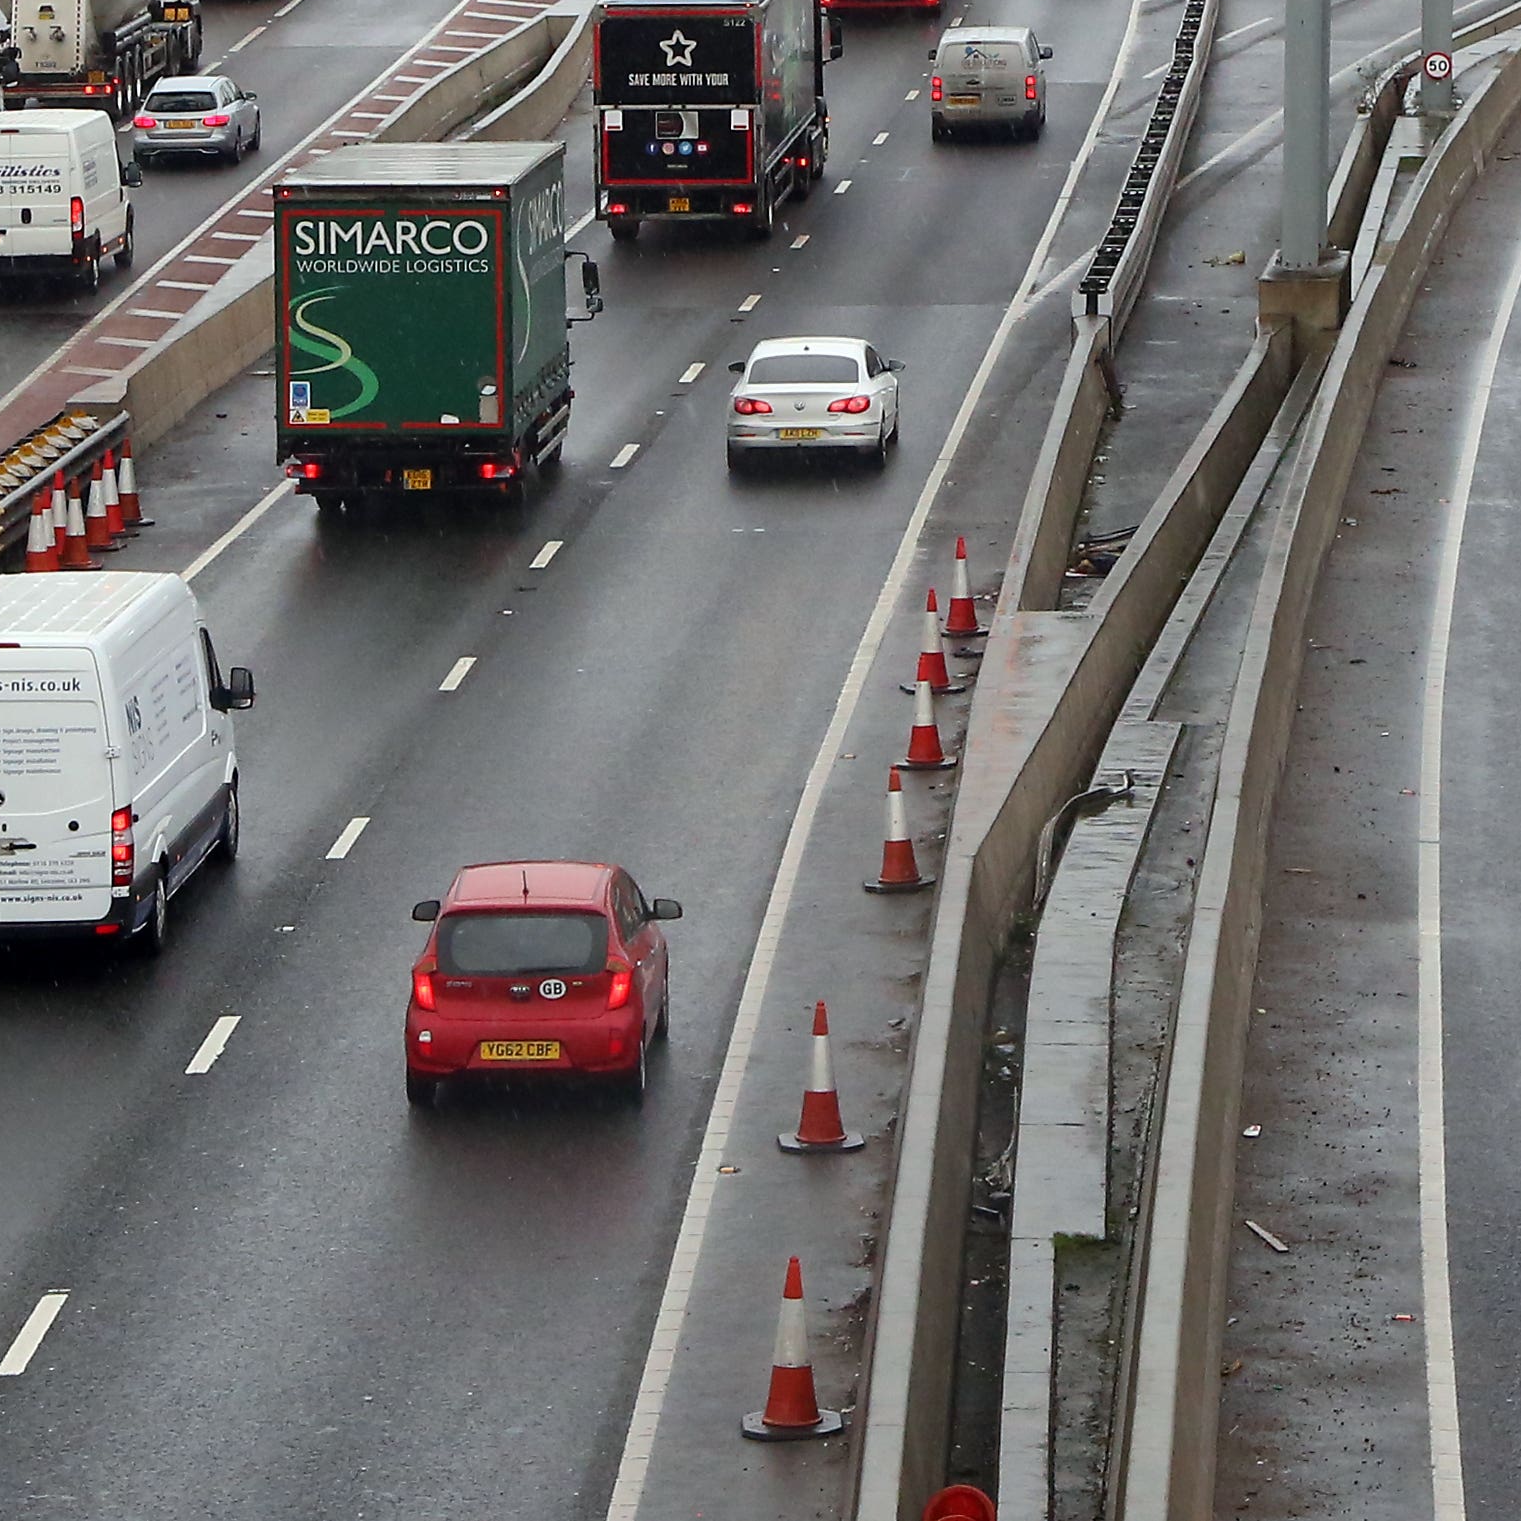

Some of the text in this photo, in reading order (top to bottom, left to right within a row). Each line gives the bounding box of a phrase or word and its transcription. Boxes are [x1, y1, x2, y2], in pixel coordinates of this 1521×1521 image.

[1429, 60, 1448, 72] 50
[629, 73, 729, 86] SAVE MORE WITH YOUR
[9, 184, 62, 195] 315149
[295, 220, 488, 256] SIMARCO
[296, 259, 489, 274] WORLDWIDE LOGISTICS
[0, 894, 83, 903] www.signs-nis.co.uk
[542, 982, 563, 996] GB
[486, 1042, 554, 1057] YG62 CBF
